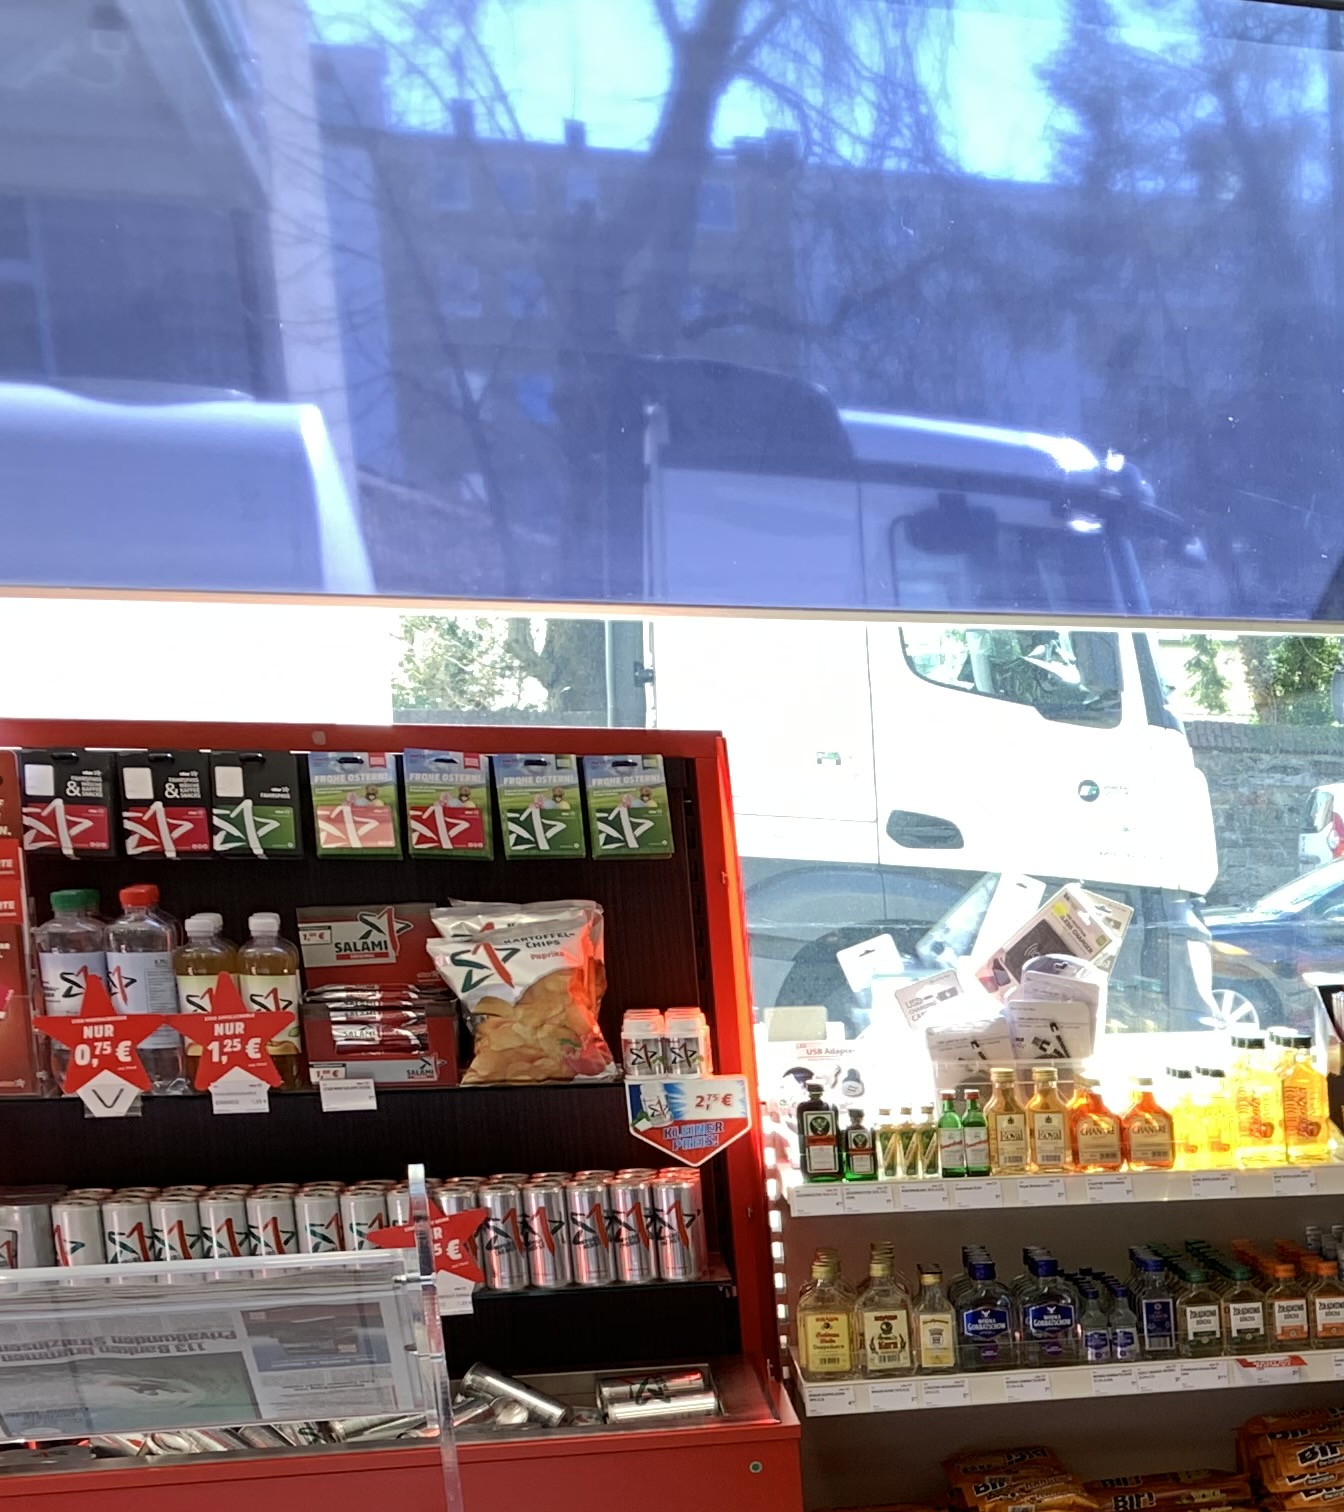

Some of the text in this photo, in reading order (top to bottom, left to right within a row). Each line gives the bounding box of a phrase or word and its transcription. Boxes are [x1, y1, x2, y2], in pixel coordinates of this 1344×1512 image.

[335, 941, 388, 953] SALAMI
[526, 940, 561, 949] CHIPS
[531, 951, 565, 961] Paprika
[83, 1025, 114, 1039] NUR
[214, 1022, 244, 1036] NUR
[74, 1041, 132, 1067] 0,75 €
[207, 1038, 261, 1064] 1,25 €
[722, 1094, 732, 1106] €
[1000, 1131, 1024, 1141] Royal
[1037, 1129, 1062, 1141] Royal
[111, 1330, 236, 1346] Privatkunden
